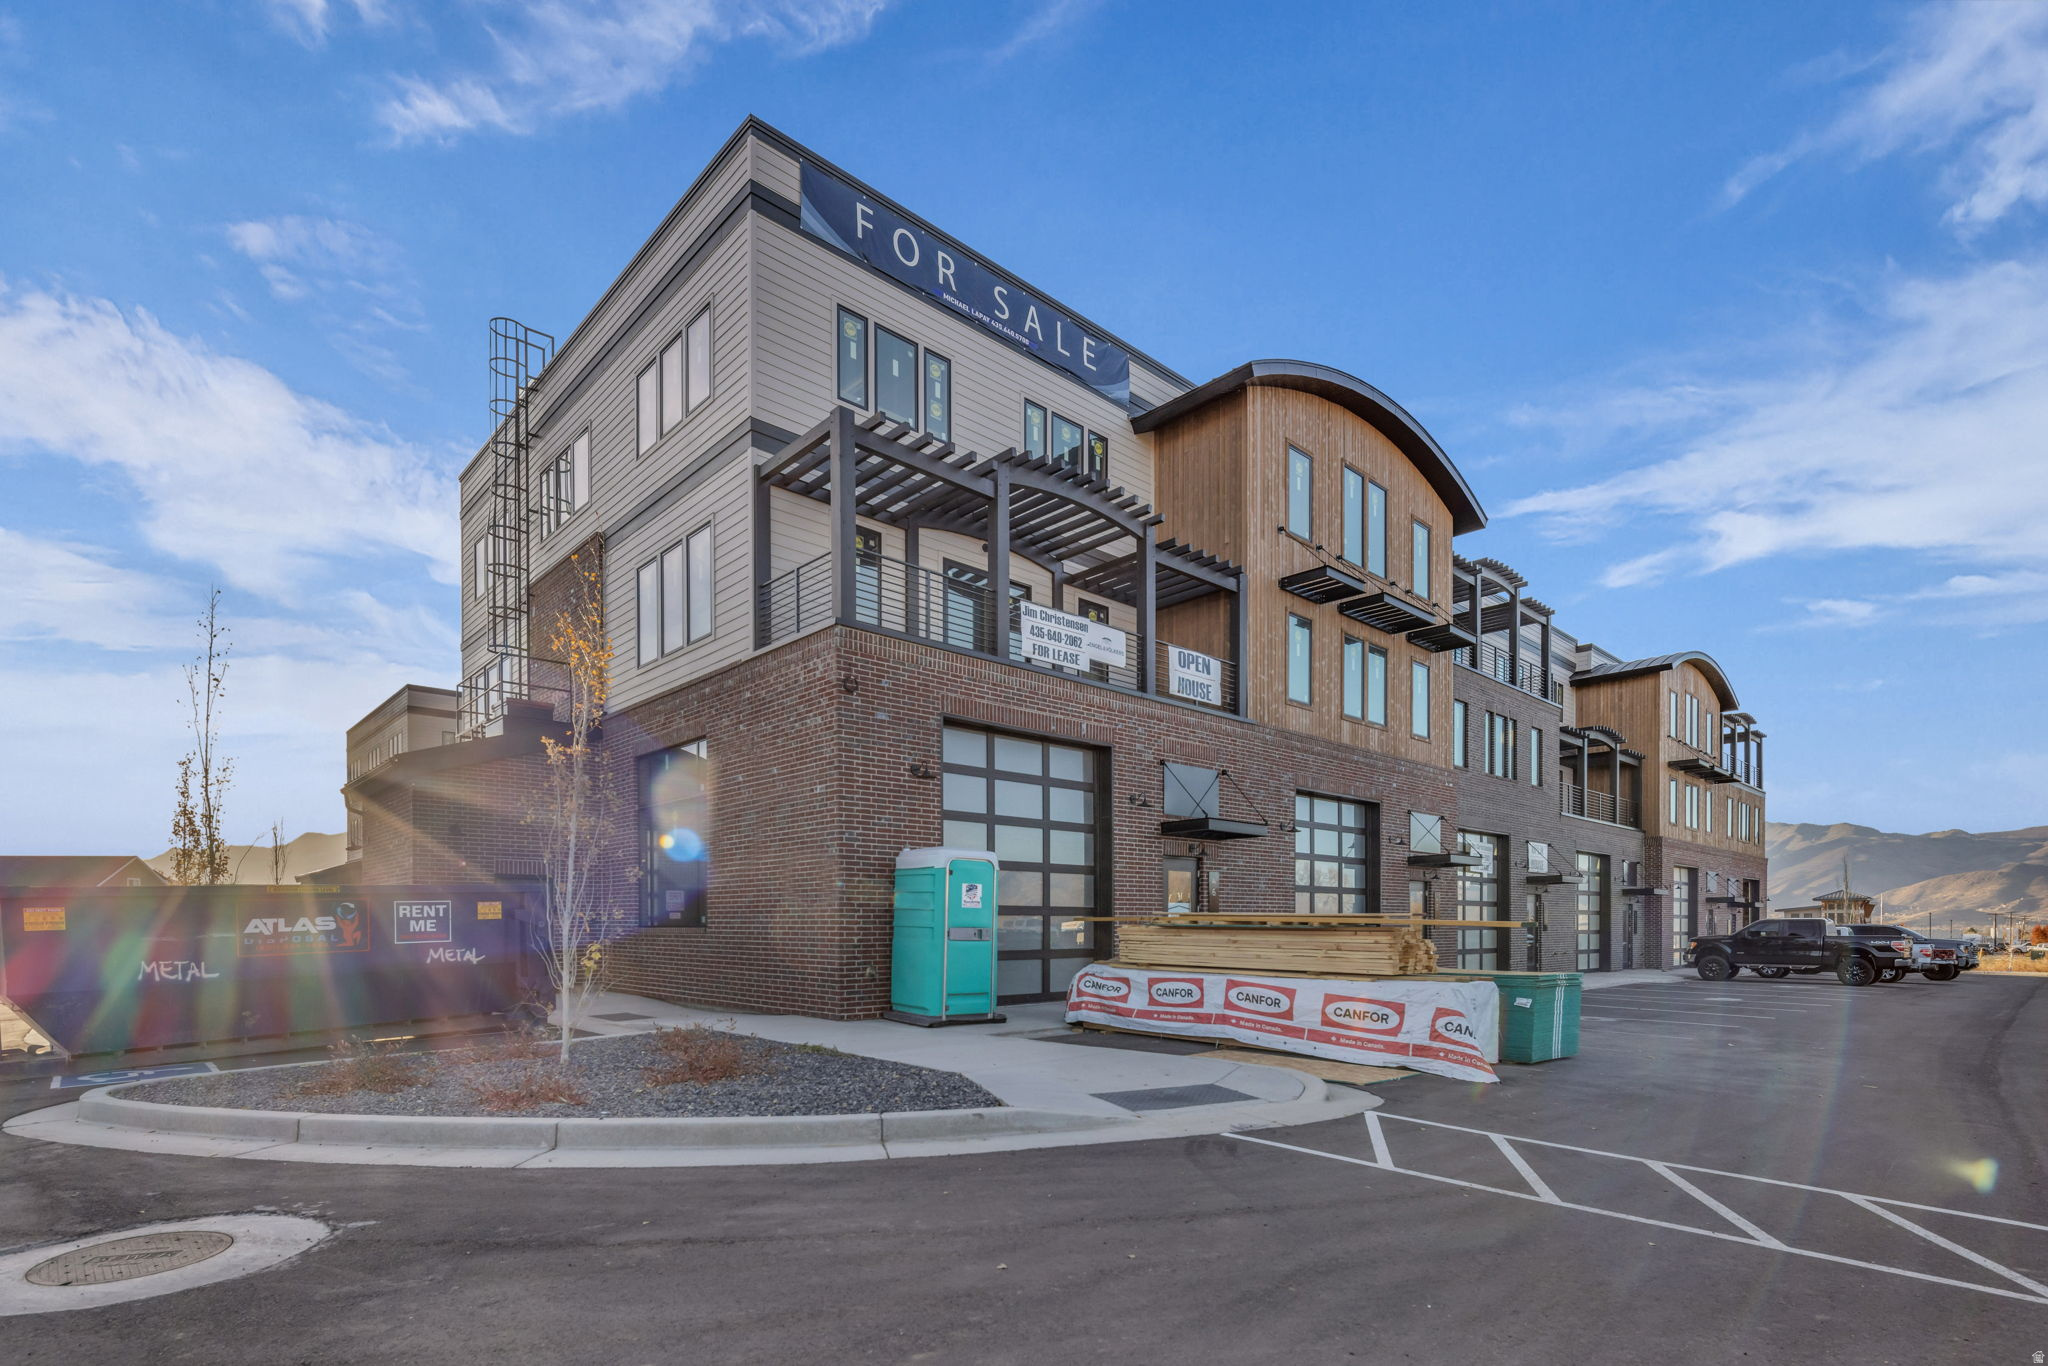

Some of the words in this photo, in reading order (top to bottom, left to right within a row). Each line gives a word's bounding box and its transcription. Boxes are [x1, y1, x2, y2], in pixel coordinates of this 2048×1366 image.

[856, 202, 957, 292] FOR
[994, 286, 1097, 372] SALE
[943, 293, 970, 313] MICHAEL
[1022, 605, 1038, 619] Jim
[1039, 609, 1089, 633] Christensen
[1030, 624, 1083, 649] 435-640-2062
[1032, 643, 1050, 659] FOR
[1052, 649, 1081, 666] LEASE
[1178, 650, 1211, 676] OPEN
[1177, 676, 1212, 702] HOUSE
[399, 904, 447, 918] RENT
[243, 916, 337, 935] ATLAS
[409, 919, 437, 932] ME
[426, 947, 486, 964] METAL
[137, 960, 220, 982] METAL
[1083, 980, 1122, 994] CANFOR
[1156, 987, 1194, 998] CANFOR
[1236, 991, 1281, 1008] CANFOR
[1239, 1020, 1254, 1028] Made
[1333, 1007, 1389, 1024] CANFOR
[1444, 1021, 1477, 1040] CAN
[1339, 1037, 1356, 1045] Made
